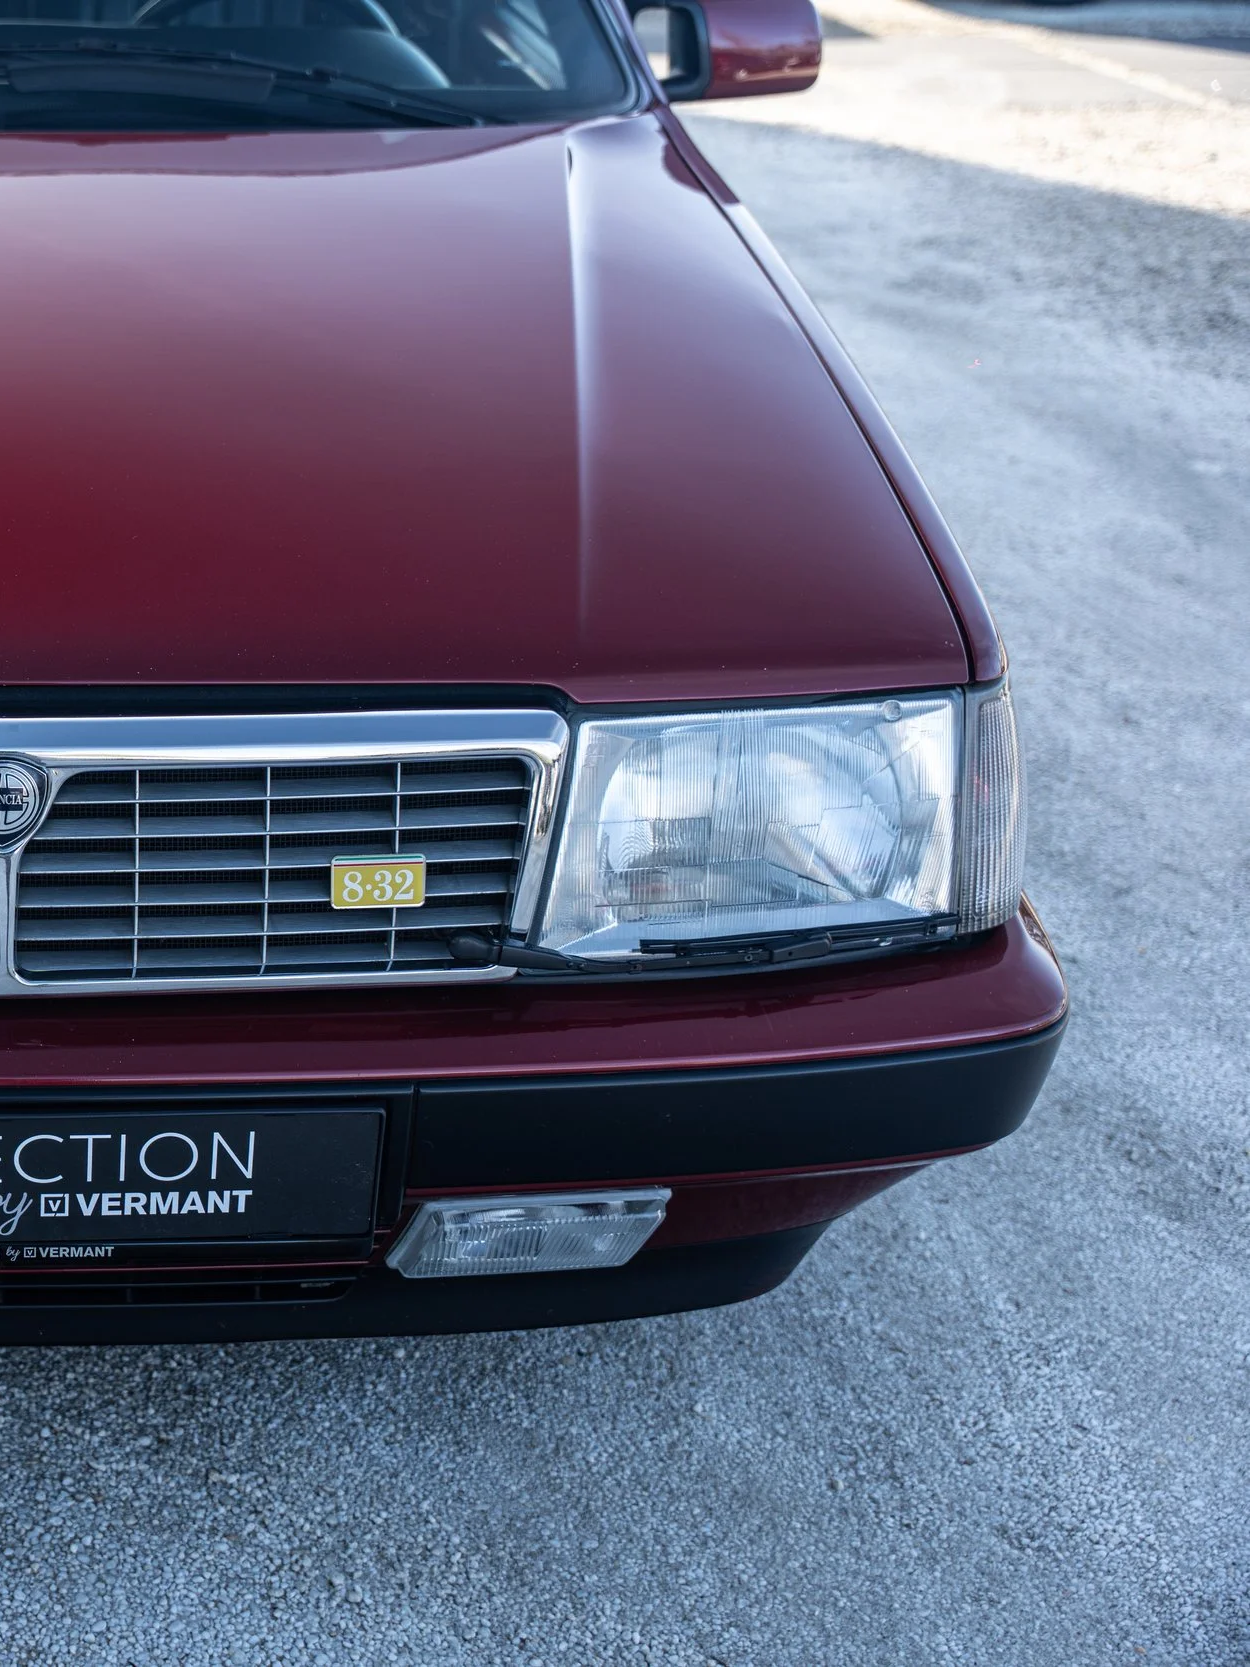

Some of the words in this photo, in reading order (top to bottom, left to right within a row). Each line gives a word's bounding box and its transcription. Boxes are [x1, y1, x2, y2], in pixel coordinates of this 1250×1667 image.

[75, 1189, 253, 1217] VERMANT
[5, 1246, 21, 1262] by
[38, 1246, 115, 1258] VERMANT
